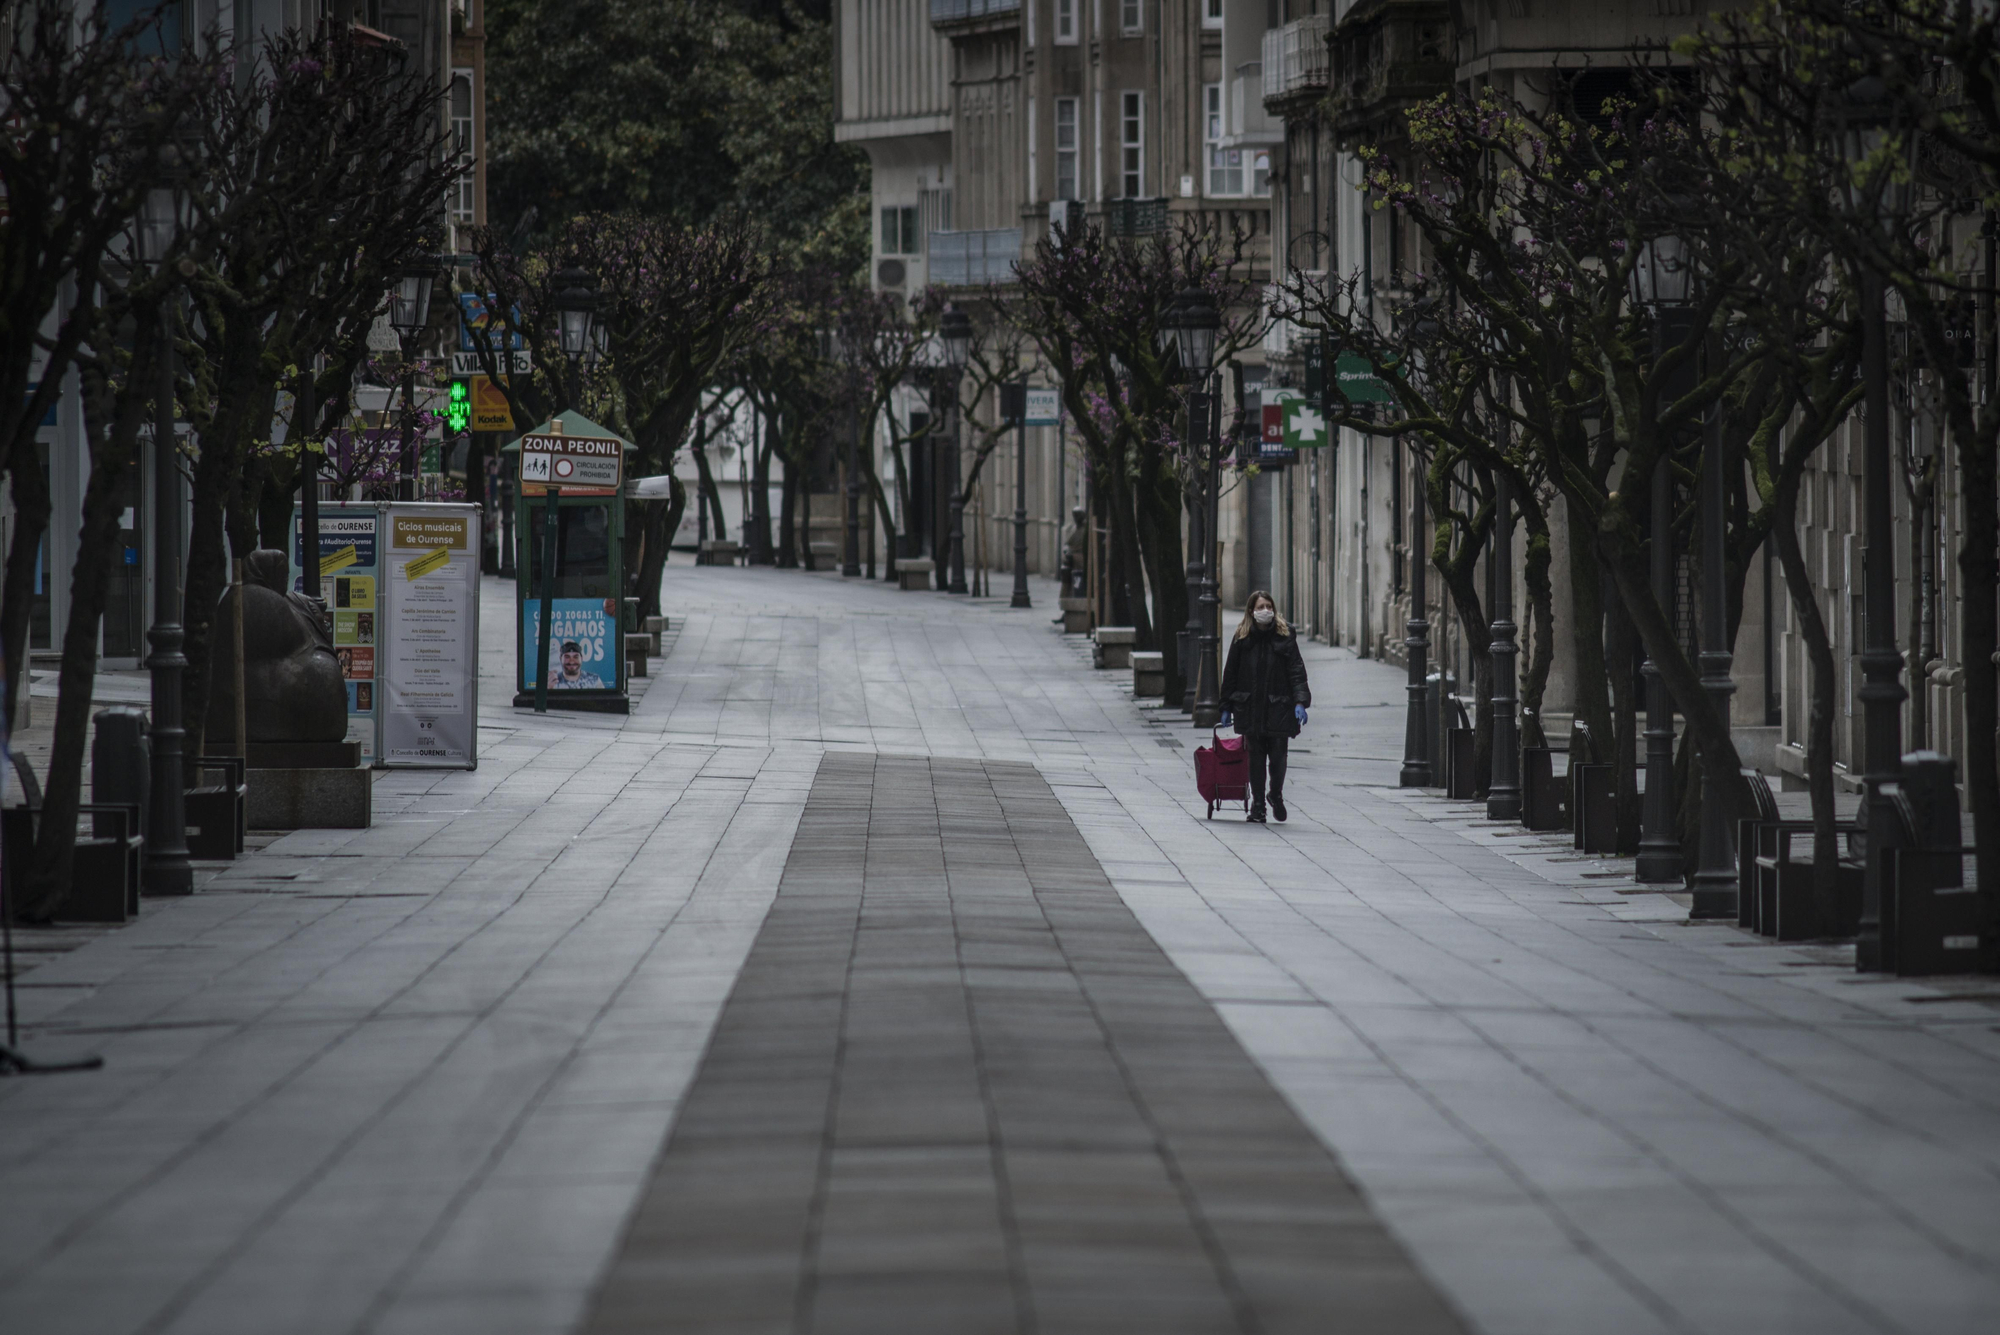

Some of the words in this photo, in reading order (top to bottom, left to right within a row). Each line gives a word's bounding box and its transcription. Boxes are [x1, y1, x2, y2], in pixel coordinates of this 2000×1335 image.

[499, 354, 528, 371] Fto
[1340, 371, 1381, 382] Sprint
[478, 414, 507, 424] Kodak
[524, 438, 562, 452] ZONA
[568, 440, 618, 455] PEONIL
[576, 462, 616, 470] CIRCULACIÓN
[338, 522, 373, 530] OURENSE
[398, 522, 422, 531] Ciclos
[424, 523, 462, 532] musicais
[406, 534, 416, 543] de
[418, 535, 454, 544] Ourense
[534, 610, 562, 620] CDO
[566, 610, 592, 620] XOGAS
